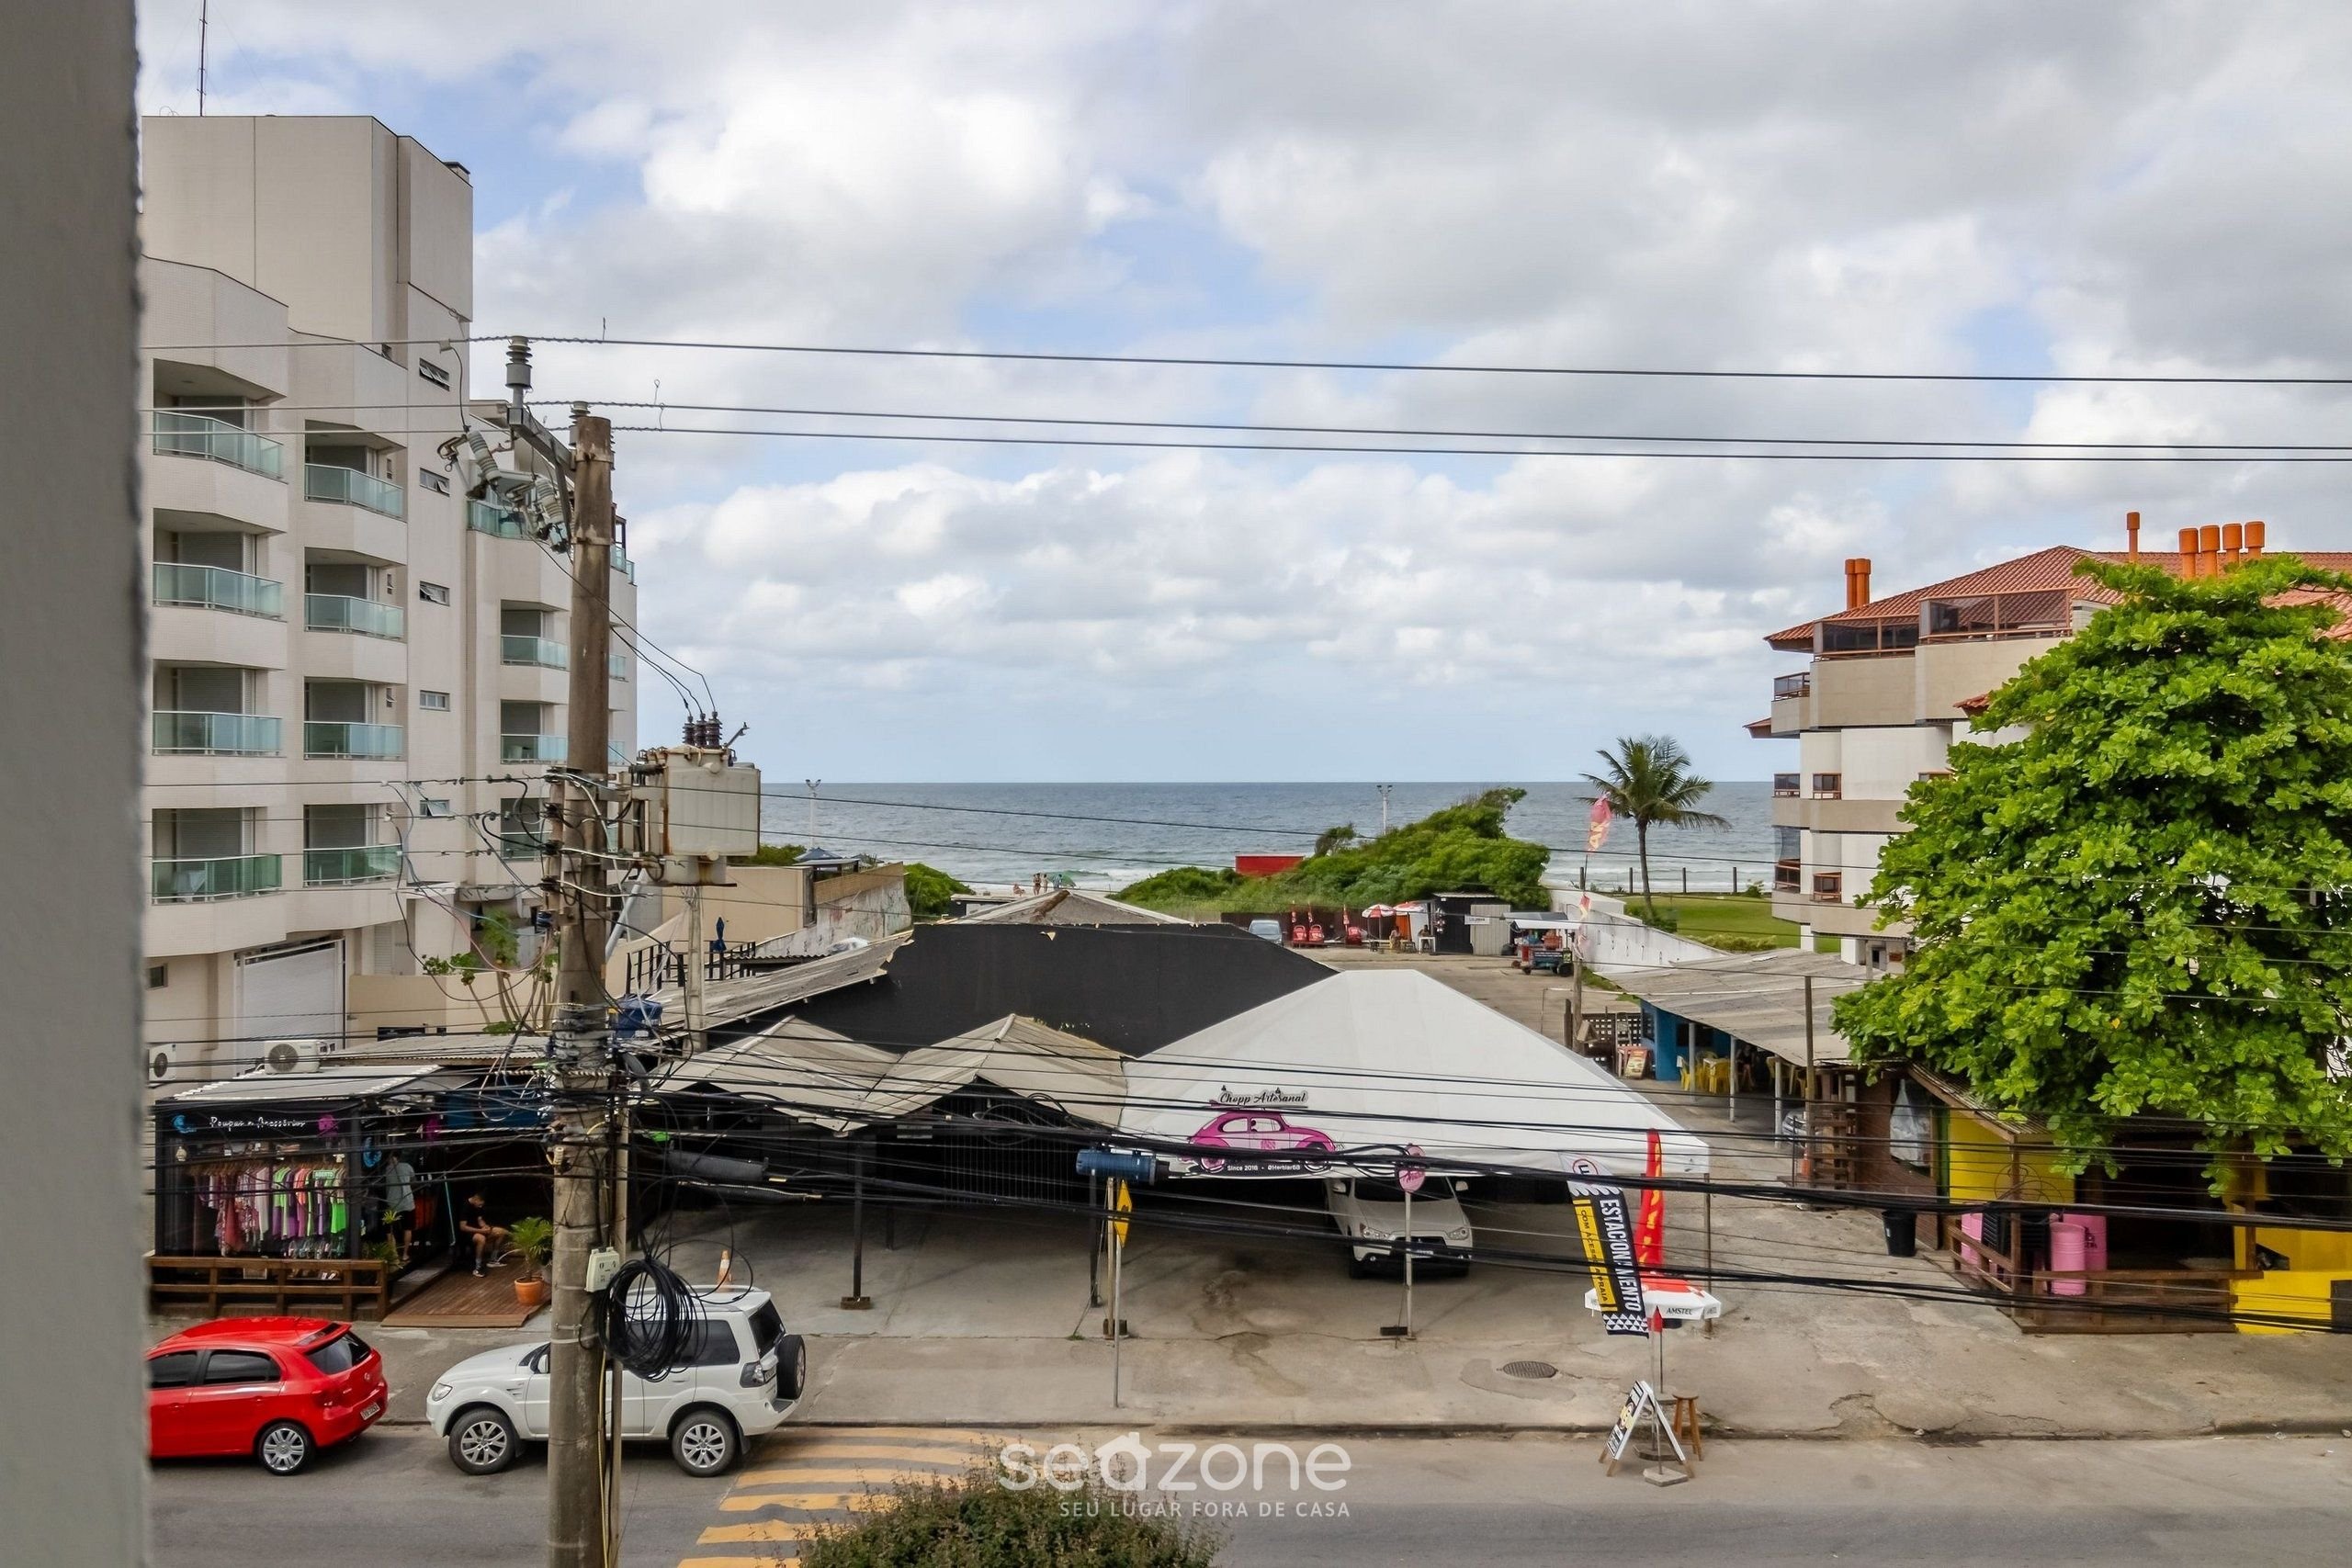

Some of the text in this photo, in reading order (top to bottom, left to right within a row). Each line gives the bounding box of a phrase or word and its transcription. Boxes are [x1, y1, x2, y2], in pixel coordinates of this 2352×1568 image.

[1220, 1091, 1306, 1106] Chopp Artesanal
[1580, 1209, 1590, 1230] COM
[1666, 1306, 1693, 1315] AMSTEL
